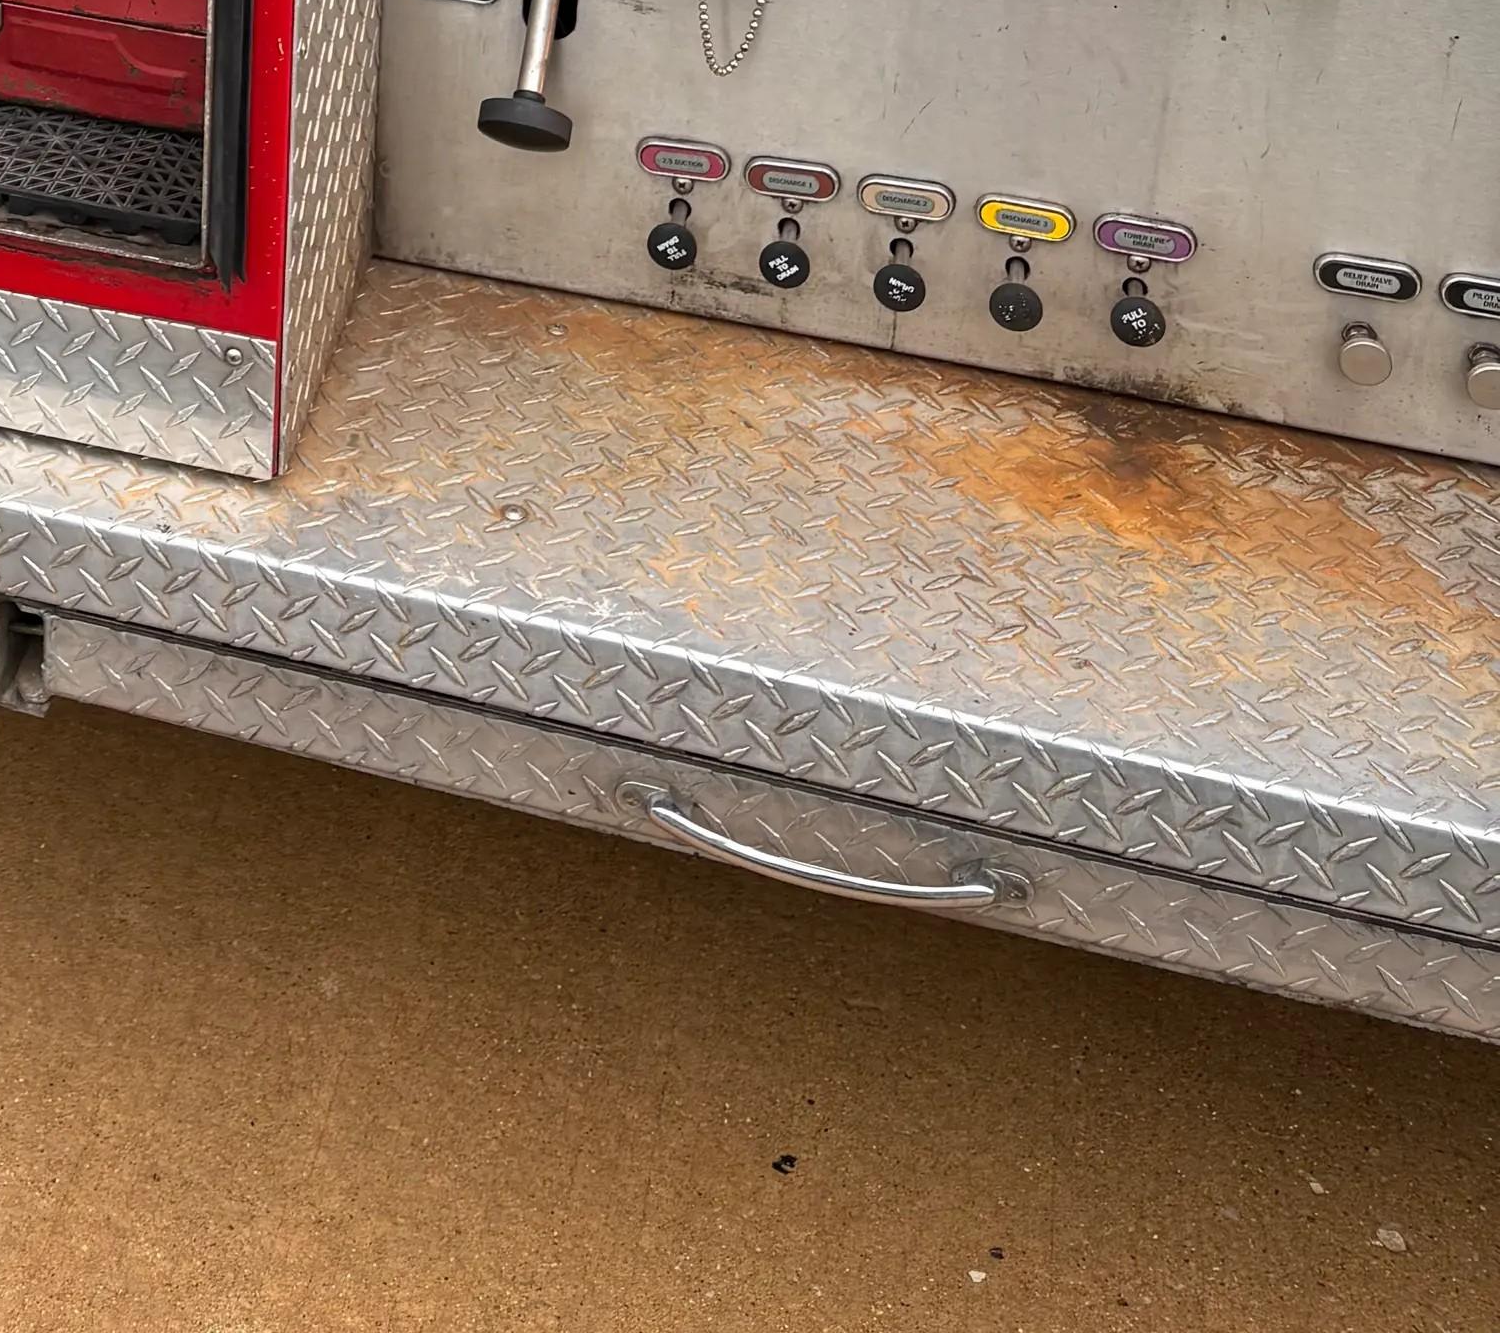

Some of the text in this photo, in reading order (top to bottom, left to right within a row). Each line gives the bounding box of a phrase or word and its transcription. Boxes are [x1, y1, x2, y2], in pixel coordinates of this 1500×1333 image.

[768, 255, 788, 268] PULL
[777, 263, 788, 272] TO
[776, 266, 799, 281] DRAIN
[1132, 319, 1146, 329] TO
